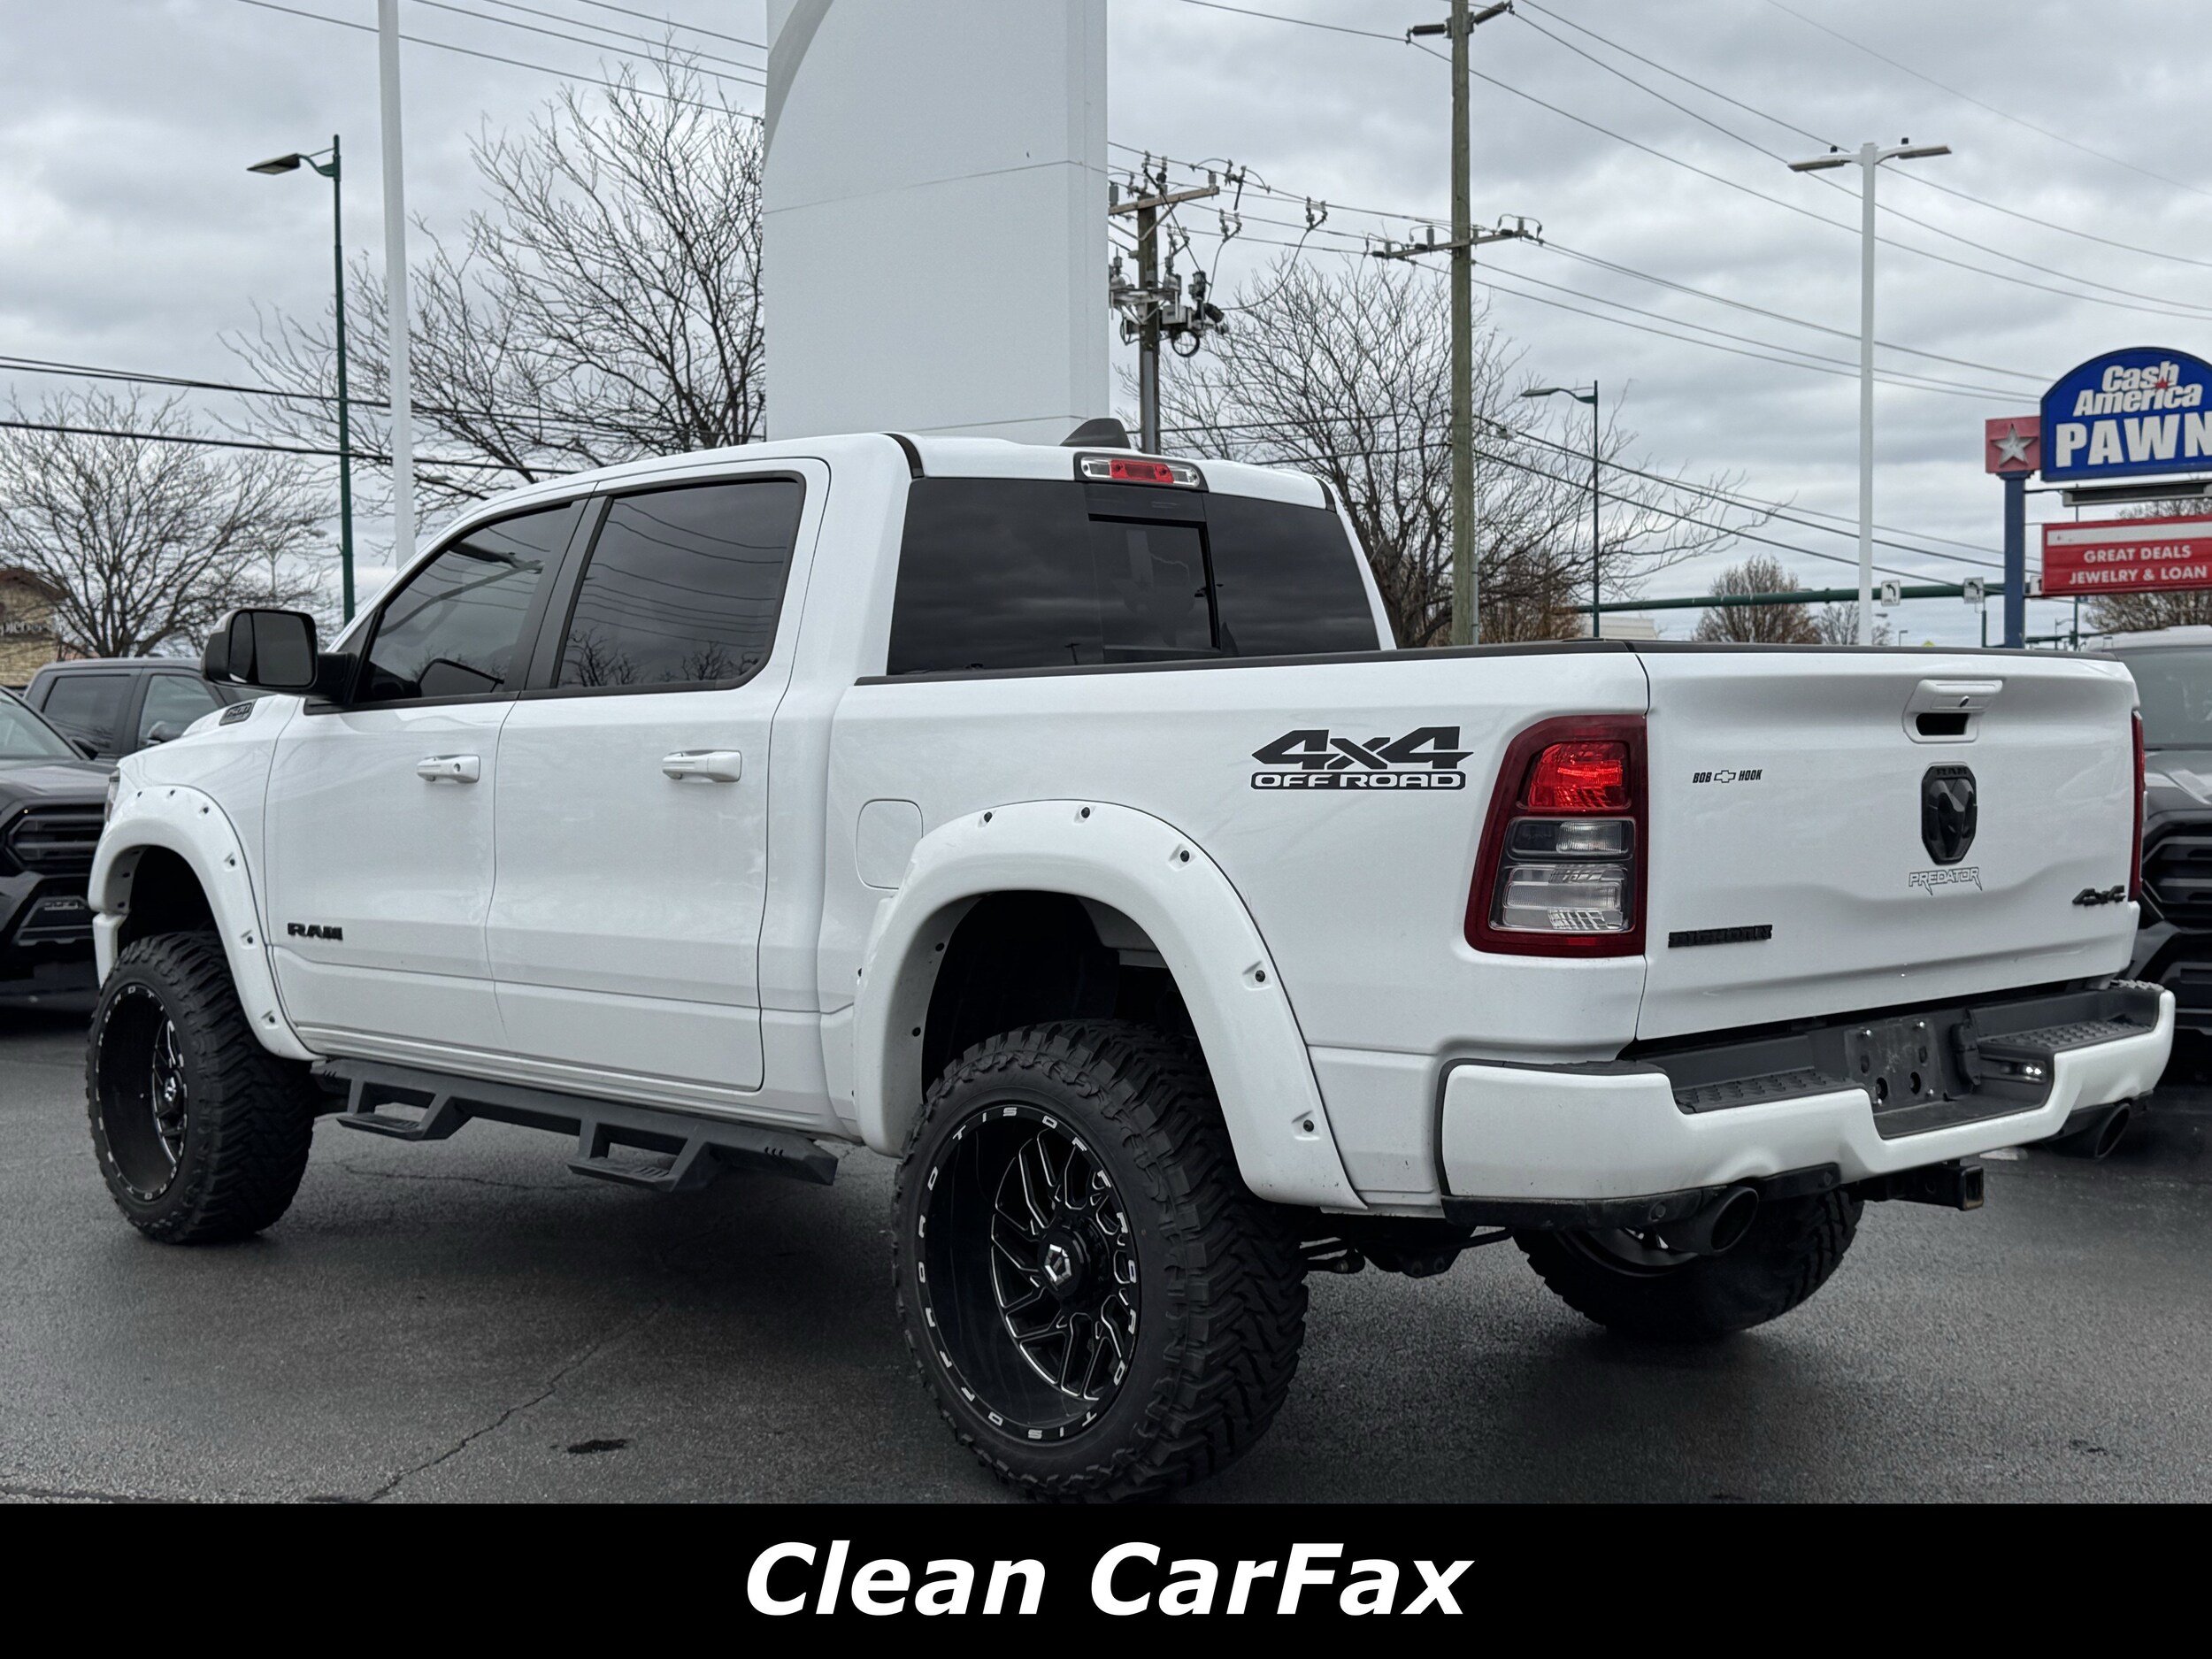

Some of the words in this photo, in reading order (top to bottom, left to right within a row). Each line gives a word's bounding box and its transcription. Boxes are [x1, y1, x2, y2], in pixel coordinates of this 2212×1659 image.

[2101, 361, 2180, 392] Cash
[2072, 383, 2203, 417] America
[2055, 411, 2212, 468] PAWN
[2084, 547, 2136, 564] GREAT
[2140, 545, 2192, 560] DEALS
[2069, 569, 2139, 585] JEWELRY
[2142, 568, 2154, 581] &
[2161, 565, 2208, 580] LOAN
[1251, 726, 1474, 771] 4x4
[1255, 774, 1333, 787] OFF
[1339, 773, 1461, 787] ROAD
[1693, 772, 1712, 783] BOB
[1738, 769, 1763, 781] HOOK
[1936, 767, 1967, 776] RAM
[1909, 866, 1983, 896] PREDATOR
[288, 923, 343, 941] RAM
